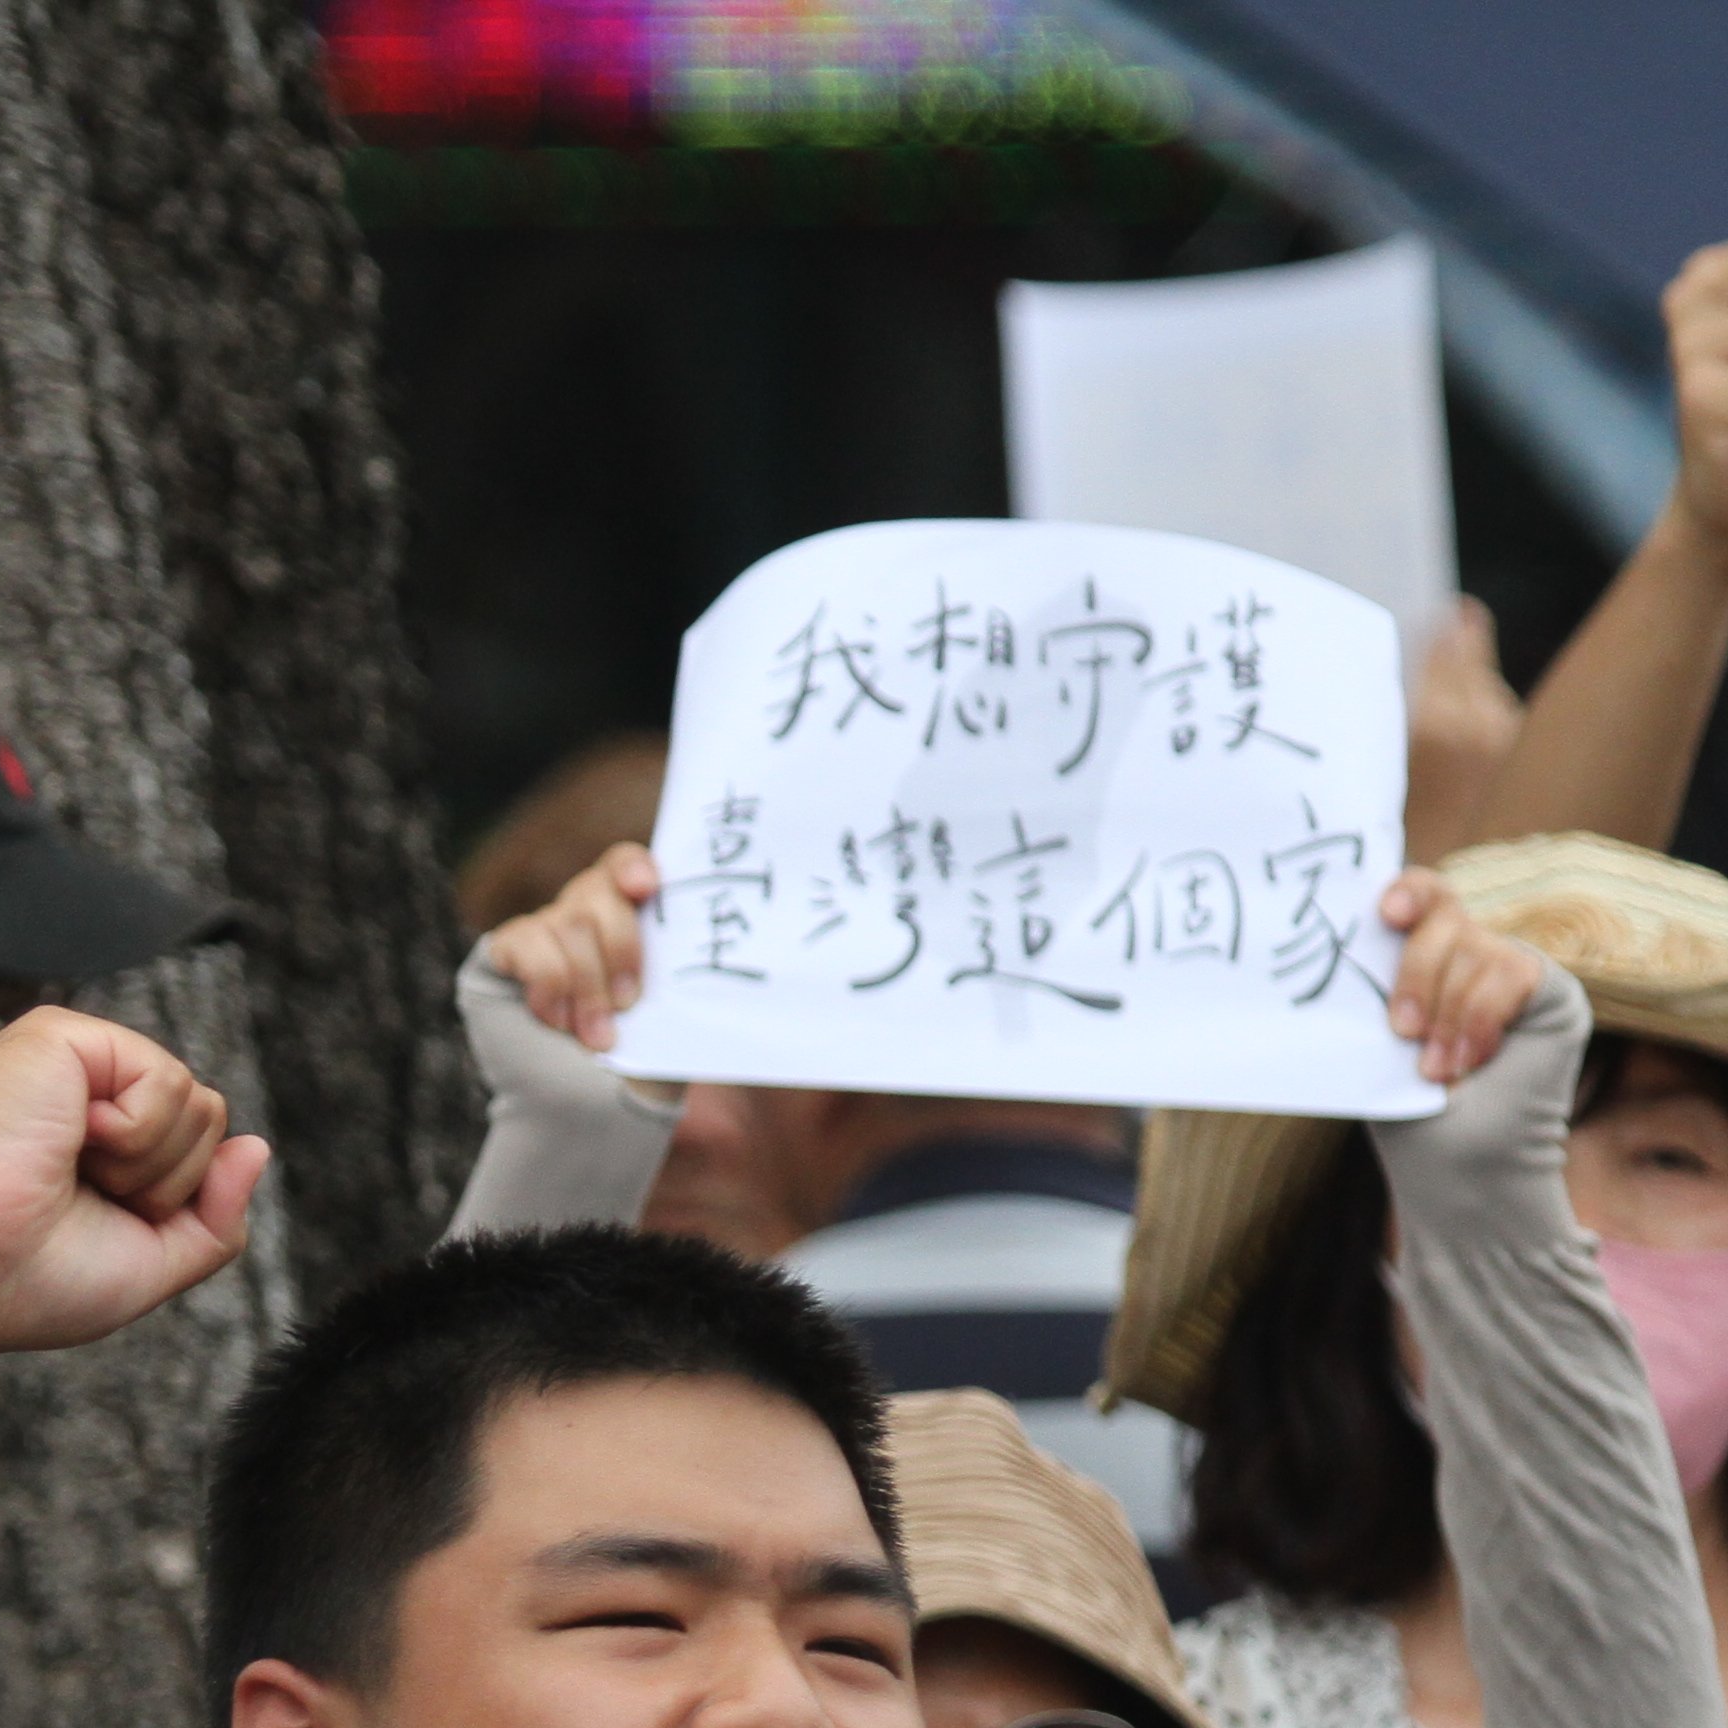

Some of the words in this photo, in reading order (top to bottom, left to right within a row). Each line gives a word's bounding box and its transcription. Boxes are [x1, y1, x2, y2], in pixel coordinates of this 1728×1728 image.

[765, 574, 1321, 777] 我想守護
[654, 782, 1391, 1013] 臺灣這個家
